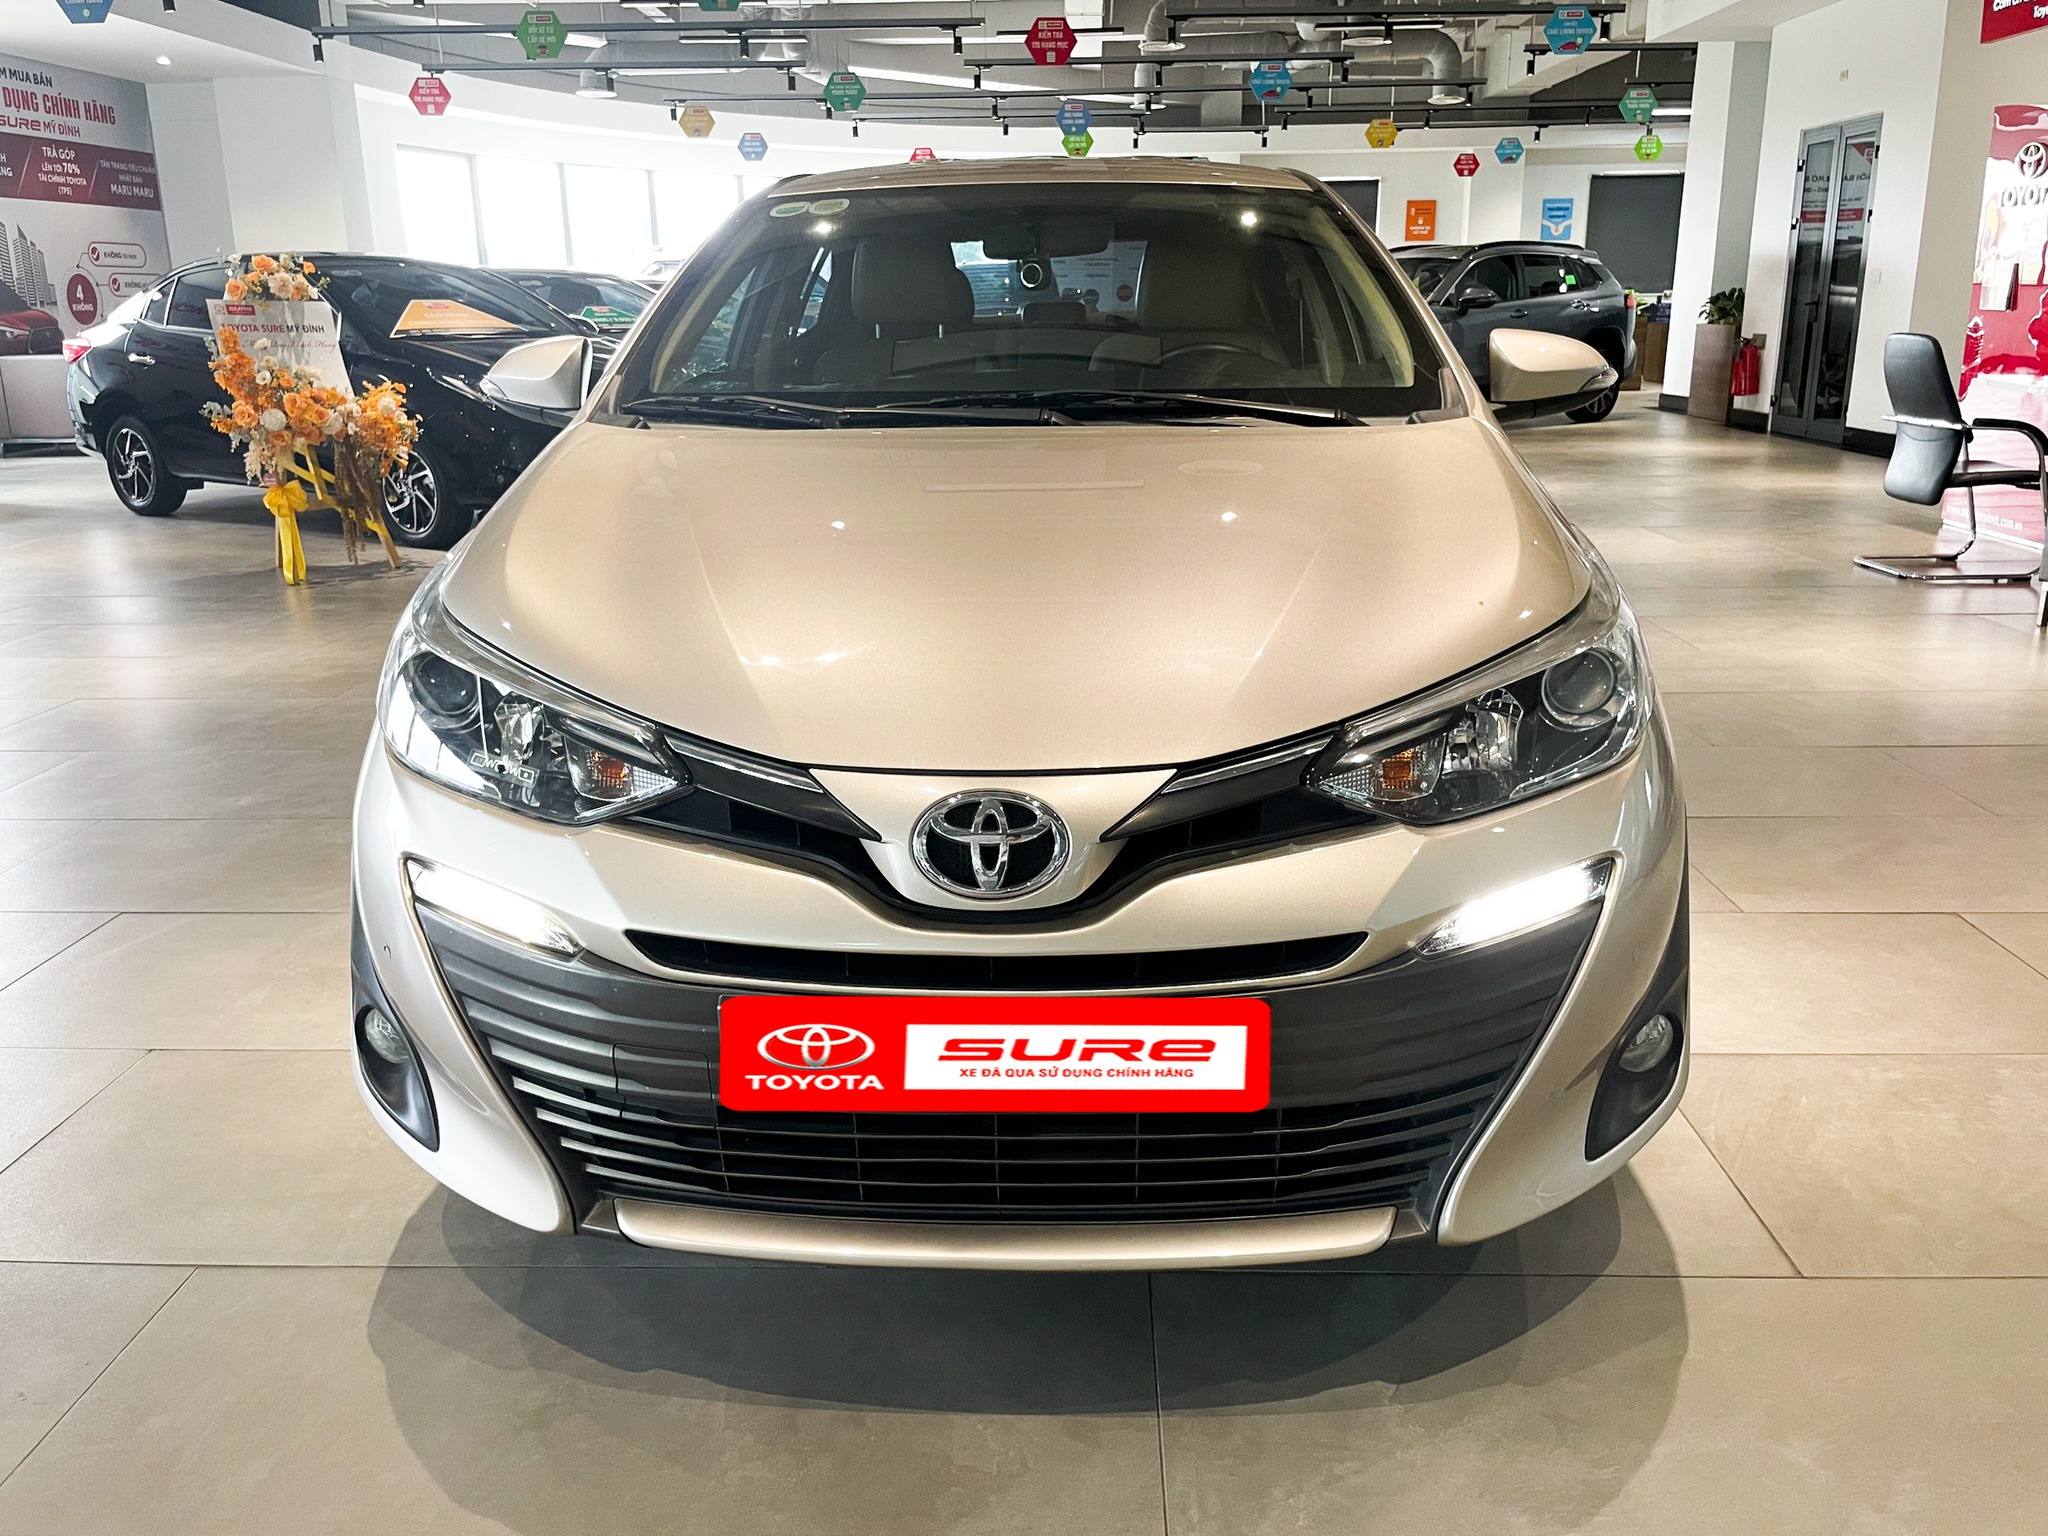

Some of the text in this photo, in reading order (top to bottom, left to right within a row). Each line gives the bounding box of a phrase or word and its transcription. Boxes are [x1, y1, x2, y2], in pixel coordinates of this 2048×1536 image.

[9, 68, 32, 84] MUA
[33, 72, 53, 88] BÁN
[2, 86, 117, 125] DỤNG CHÍNH HÃNG
[43, 119, 58, 134] MỸ
[59, 121, 81, 138] ĐÌNH
[42, 144, 76, 160] TRẢ GÓP
[41, 161, 53, 172] LÊN
[62, 162, 80, 175] 70%
[48, 173, 66, 185] CHÍNH
[66, 176, 88, 186] TOYOTA
[110, 184, 154, 198] MARU MARU
[72, 301, 94, 312] KHÔNG
[221, 321, 325, 334] OYOTA SURE MỸ ĐÌNH
